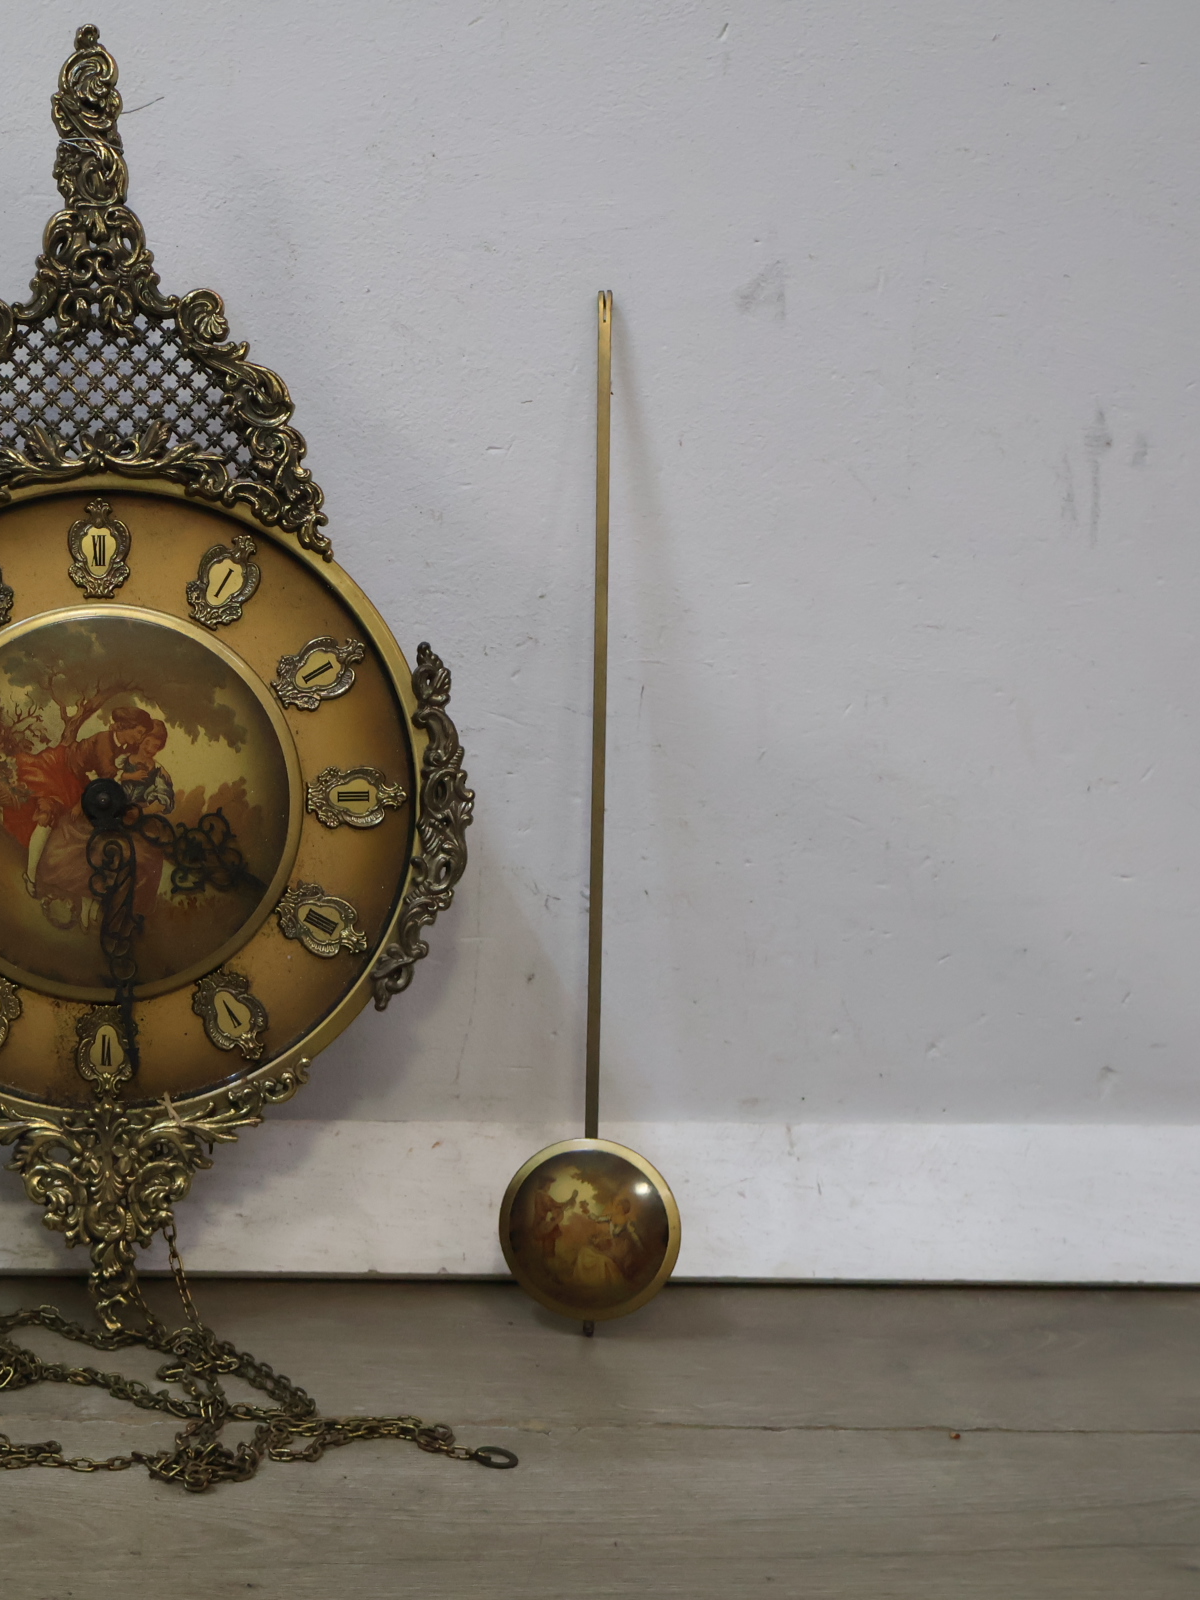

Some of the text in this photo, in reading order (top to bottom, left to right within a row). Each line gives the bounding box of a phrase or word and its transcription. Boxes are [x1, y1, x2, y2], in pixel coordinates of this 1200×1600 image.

[90, 534, 107, 567] XII
[214, 567, 235, 598] I
[302, 660, 334, 684] II
[337, 790, 370, 802] III
[303, 908, 339, 936] IIII
[222, 999, 242, 1029] V
[101, 1034, 112, 1066] VI
